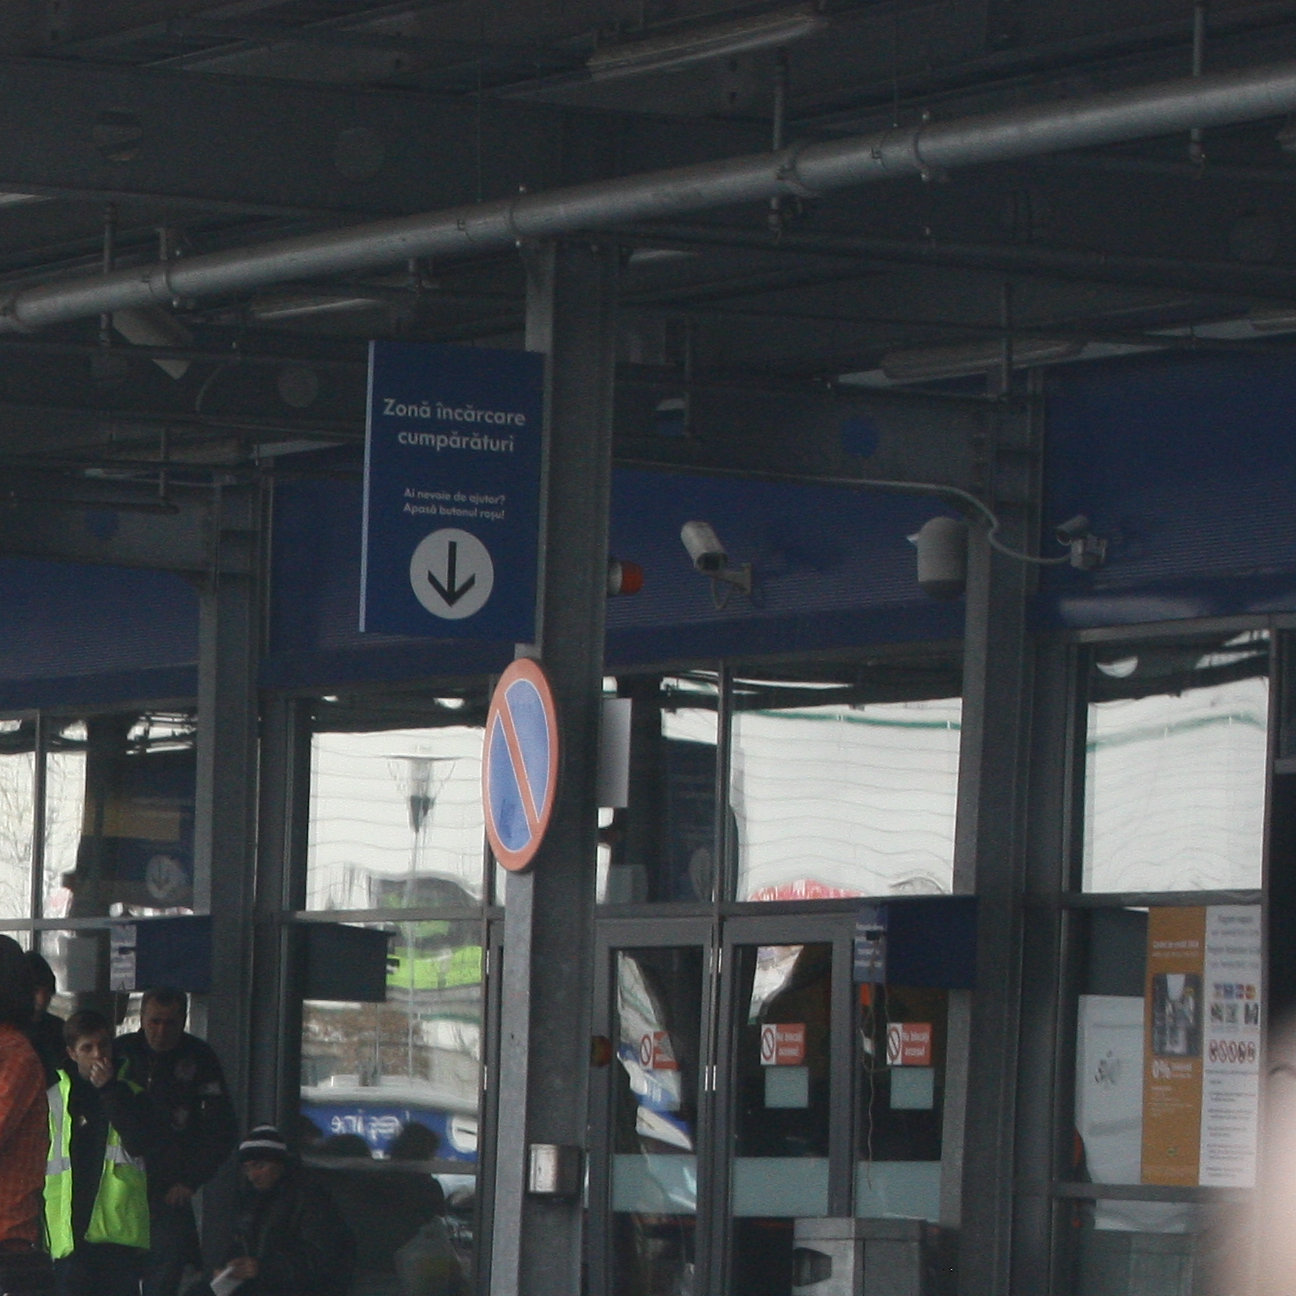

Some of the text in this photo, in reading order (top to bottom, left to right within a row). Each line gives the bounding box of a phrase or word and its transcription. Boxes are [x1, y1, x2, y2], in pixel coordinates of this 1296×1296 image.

[383, 398, 526, 426] Zonă încărcare
[398, 431, 514, 452] cumpărături
